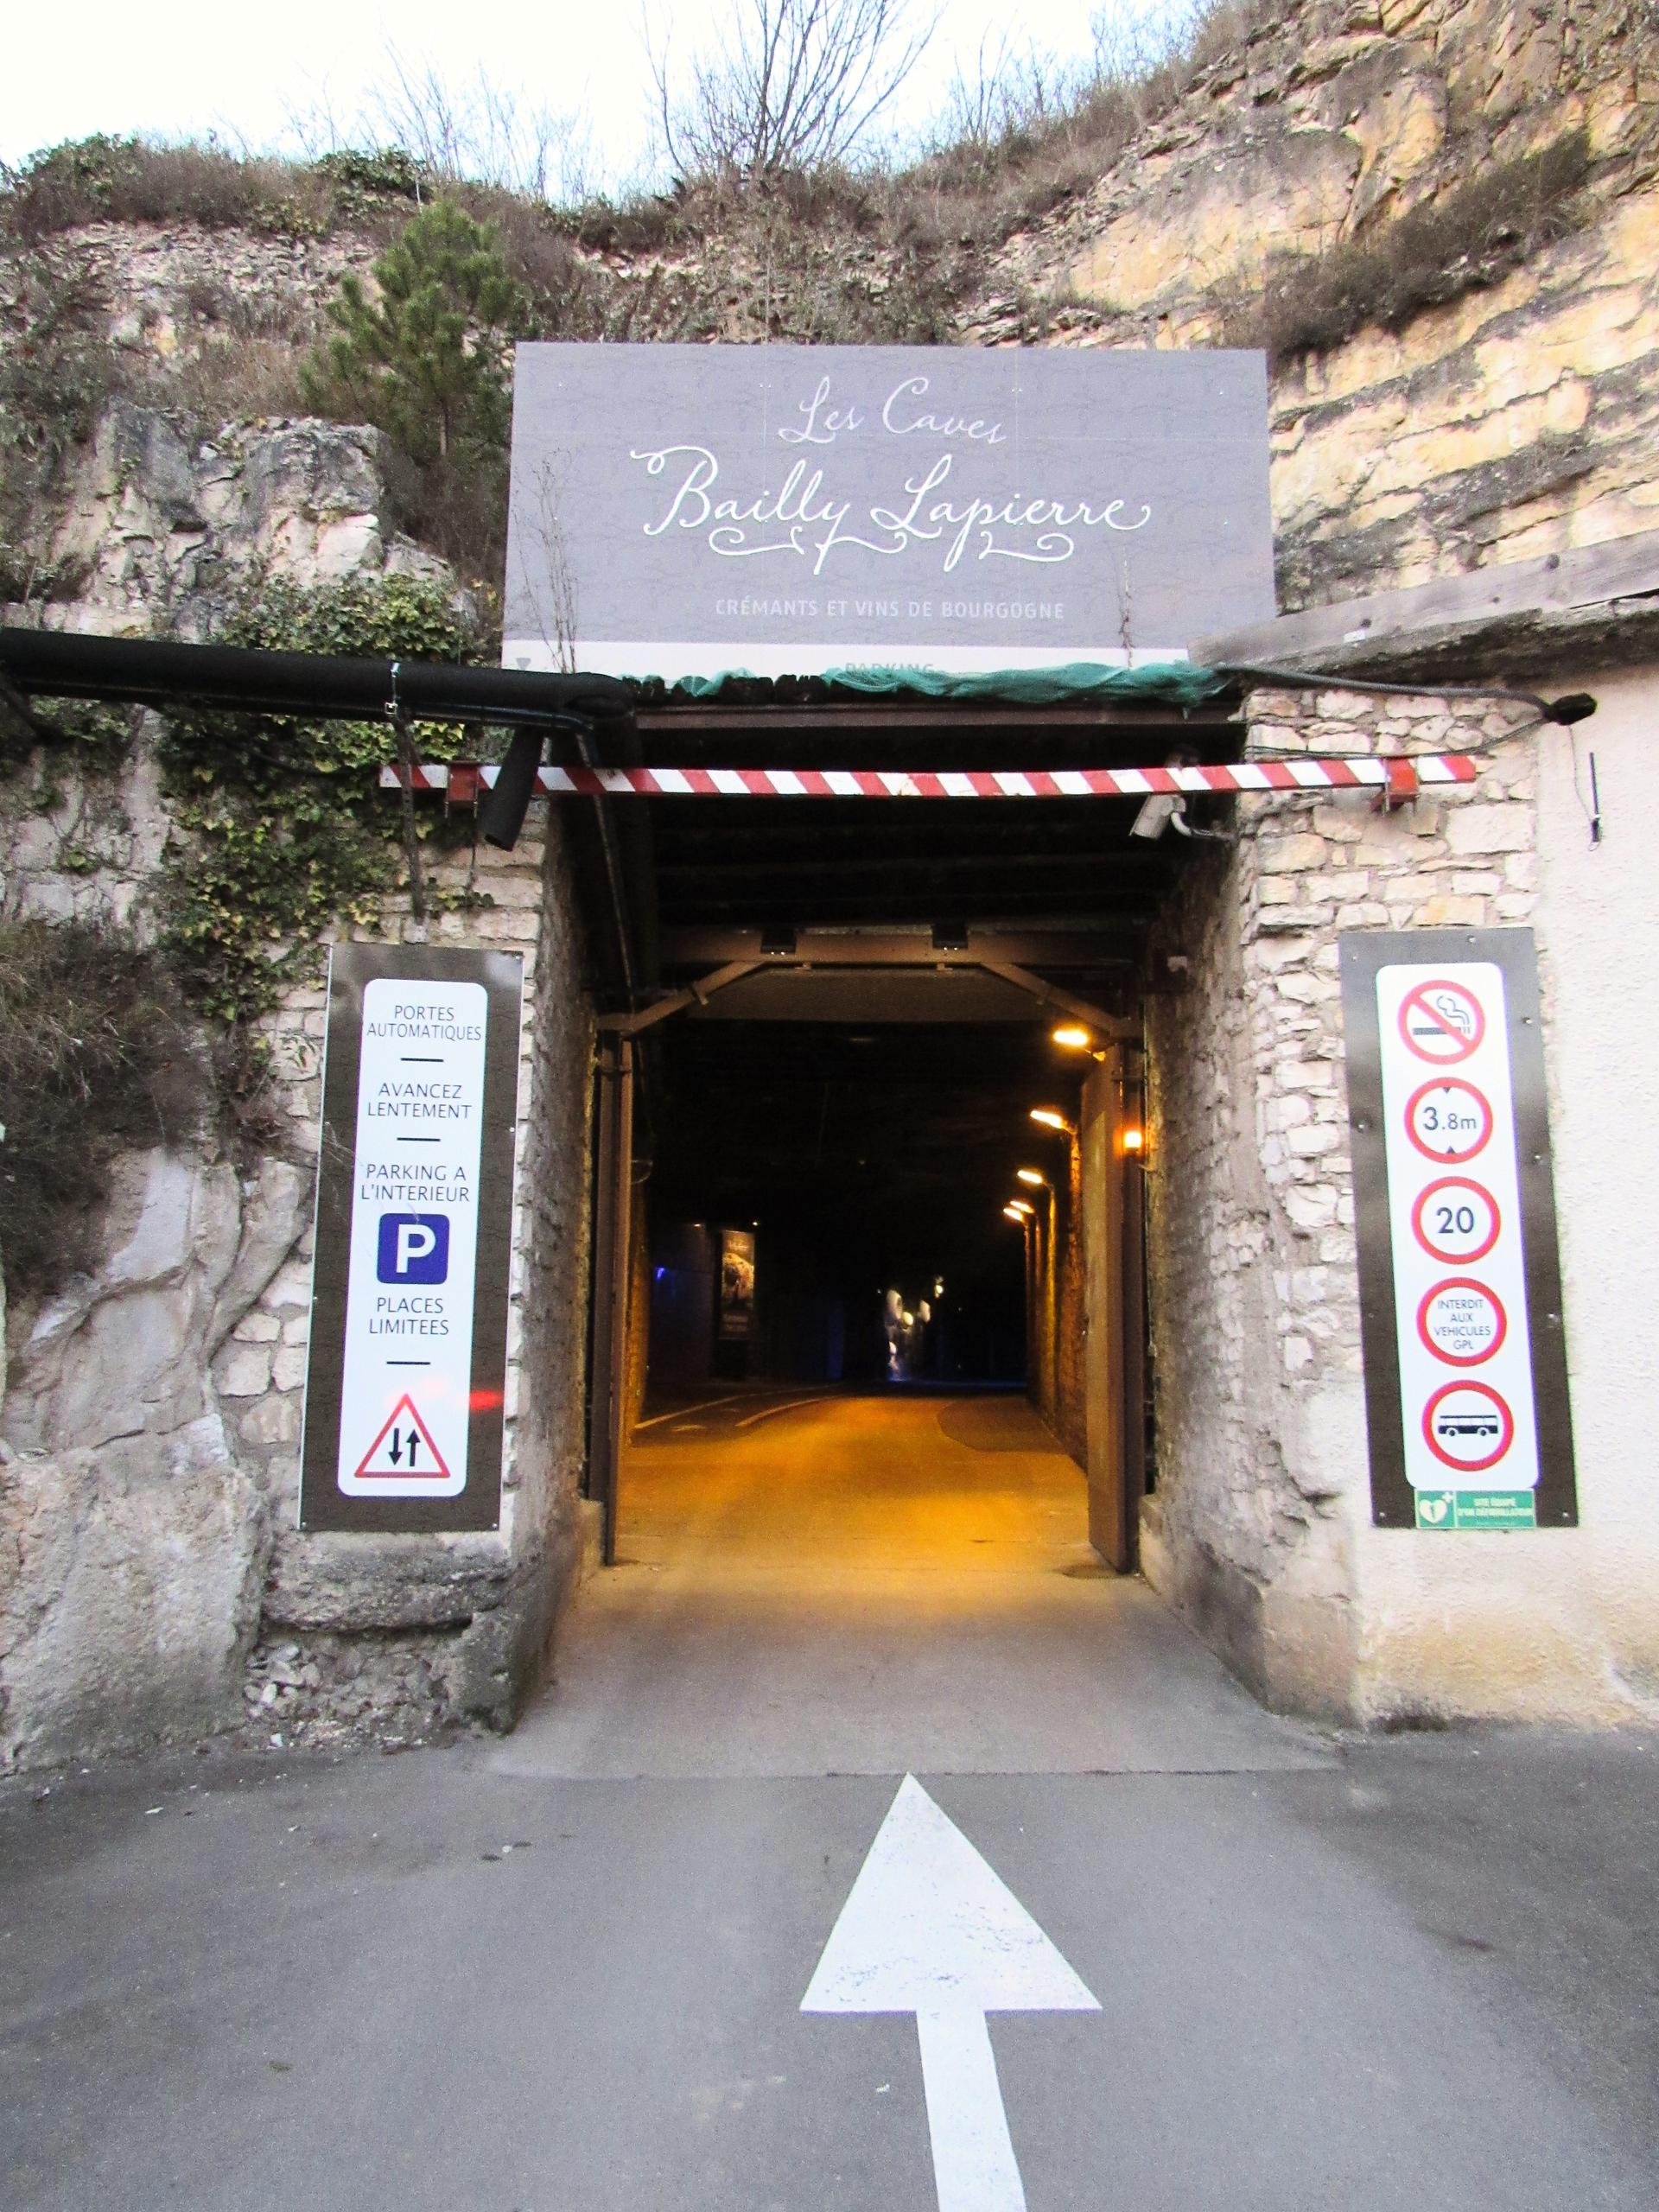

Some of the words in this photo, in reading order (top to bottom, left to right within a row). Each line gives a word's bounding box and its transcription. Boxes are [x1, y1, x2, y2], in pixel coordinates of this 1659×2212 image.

[778, 375, 865, 444] Les
[882, 377, 1007, 445] Caves
[629, 445, 864, 575] Bailly
[869, 453, 1152, 572] Lapierre
[715, 596, 818, 616] CRÉMANTS
[826, 600, 849, 616] ET
[855, 600, 899, 617] VINS
[908, 601, 933, 618] DE
[941, 601, 1065, 619] BOURGOGNE
[394, 1005, 454, 1021] PORTES
[366, 1022, 482, 1042] AUTOMATIQUES
[378, 1083, 462, 1100] AVANCEZ
[367, 1103, 473, 1119] LENTEMENT
[1422, 1106, 1478, 1131] 3.8m
[366, 1163, 447, 1181] PARKING
[454, 1166, 467, 1181] A
[361, 1185, 470, 1202] L'INTERIEUR
[1435, 1206, 1475, 1234] 20
[395, 1224, 436, 1274] P
[376, 1297, 444, 1313] PLACES
[1437, 1299, 1484, 1309] INTERDIT
[1450, 1313, 1473, 1323] AUX
[369, 1319, 449, 1336] LIMITEES
[1433, 1325, 1491, 1337] VEHICULES
[1453, 1338, 1474, 1350] GPL
